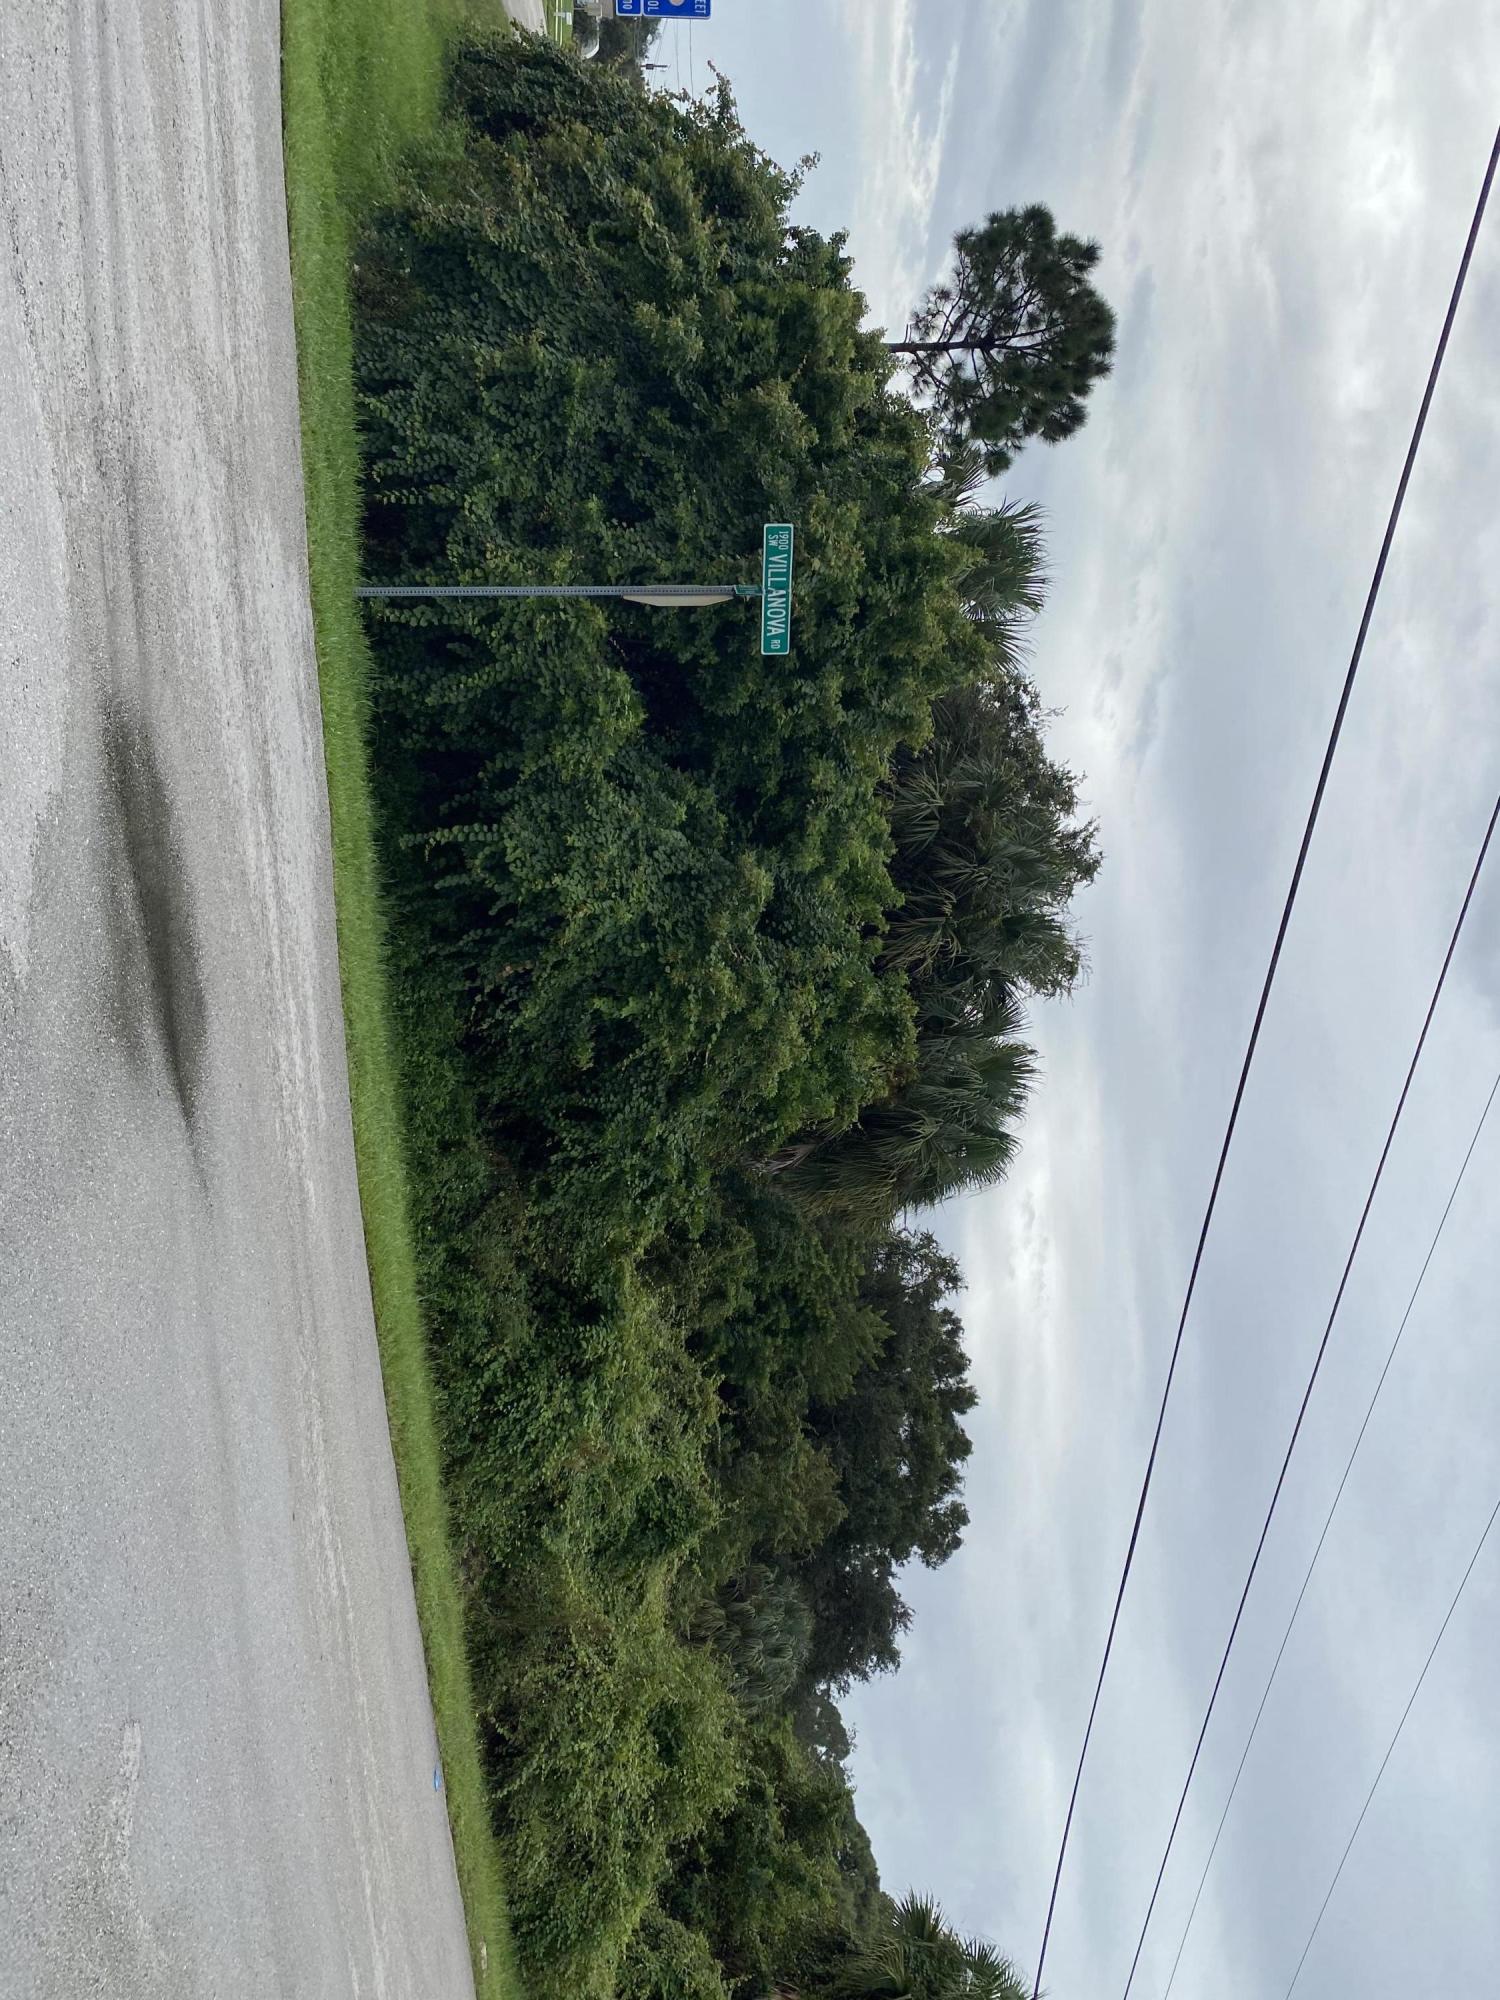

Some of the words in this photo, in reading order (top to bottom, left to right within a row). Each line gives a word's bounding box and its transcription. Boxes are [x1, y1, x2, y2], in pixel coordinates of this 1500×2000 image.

[768, 534, 779, 547] SW
[778, 531, 789, 550] 1900
[766, 553, 788, 637] VILLANOVA
[770, 639, 781, 650] RD
